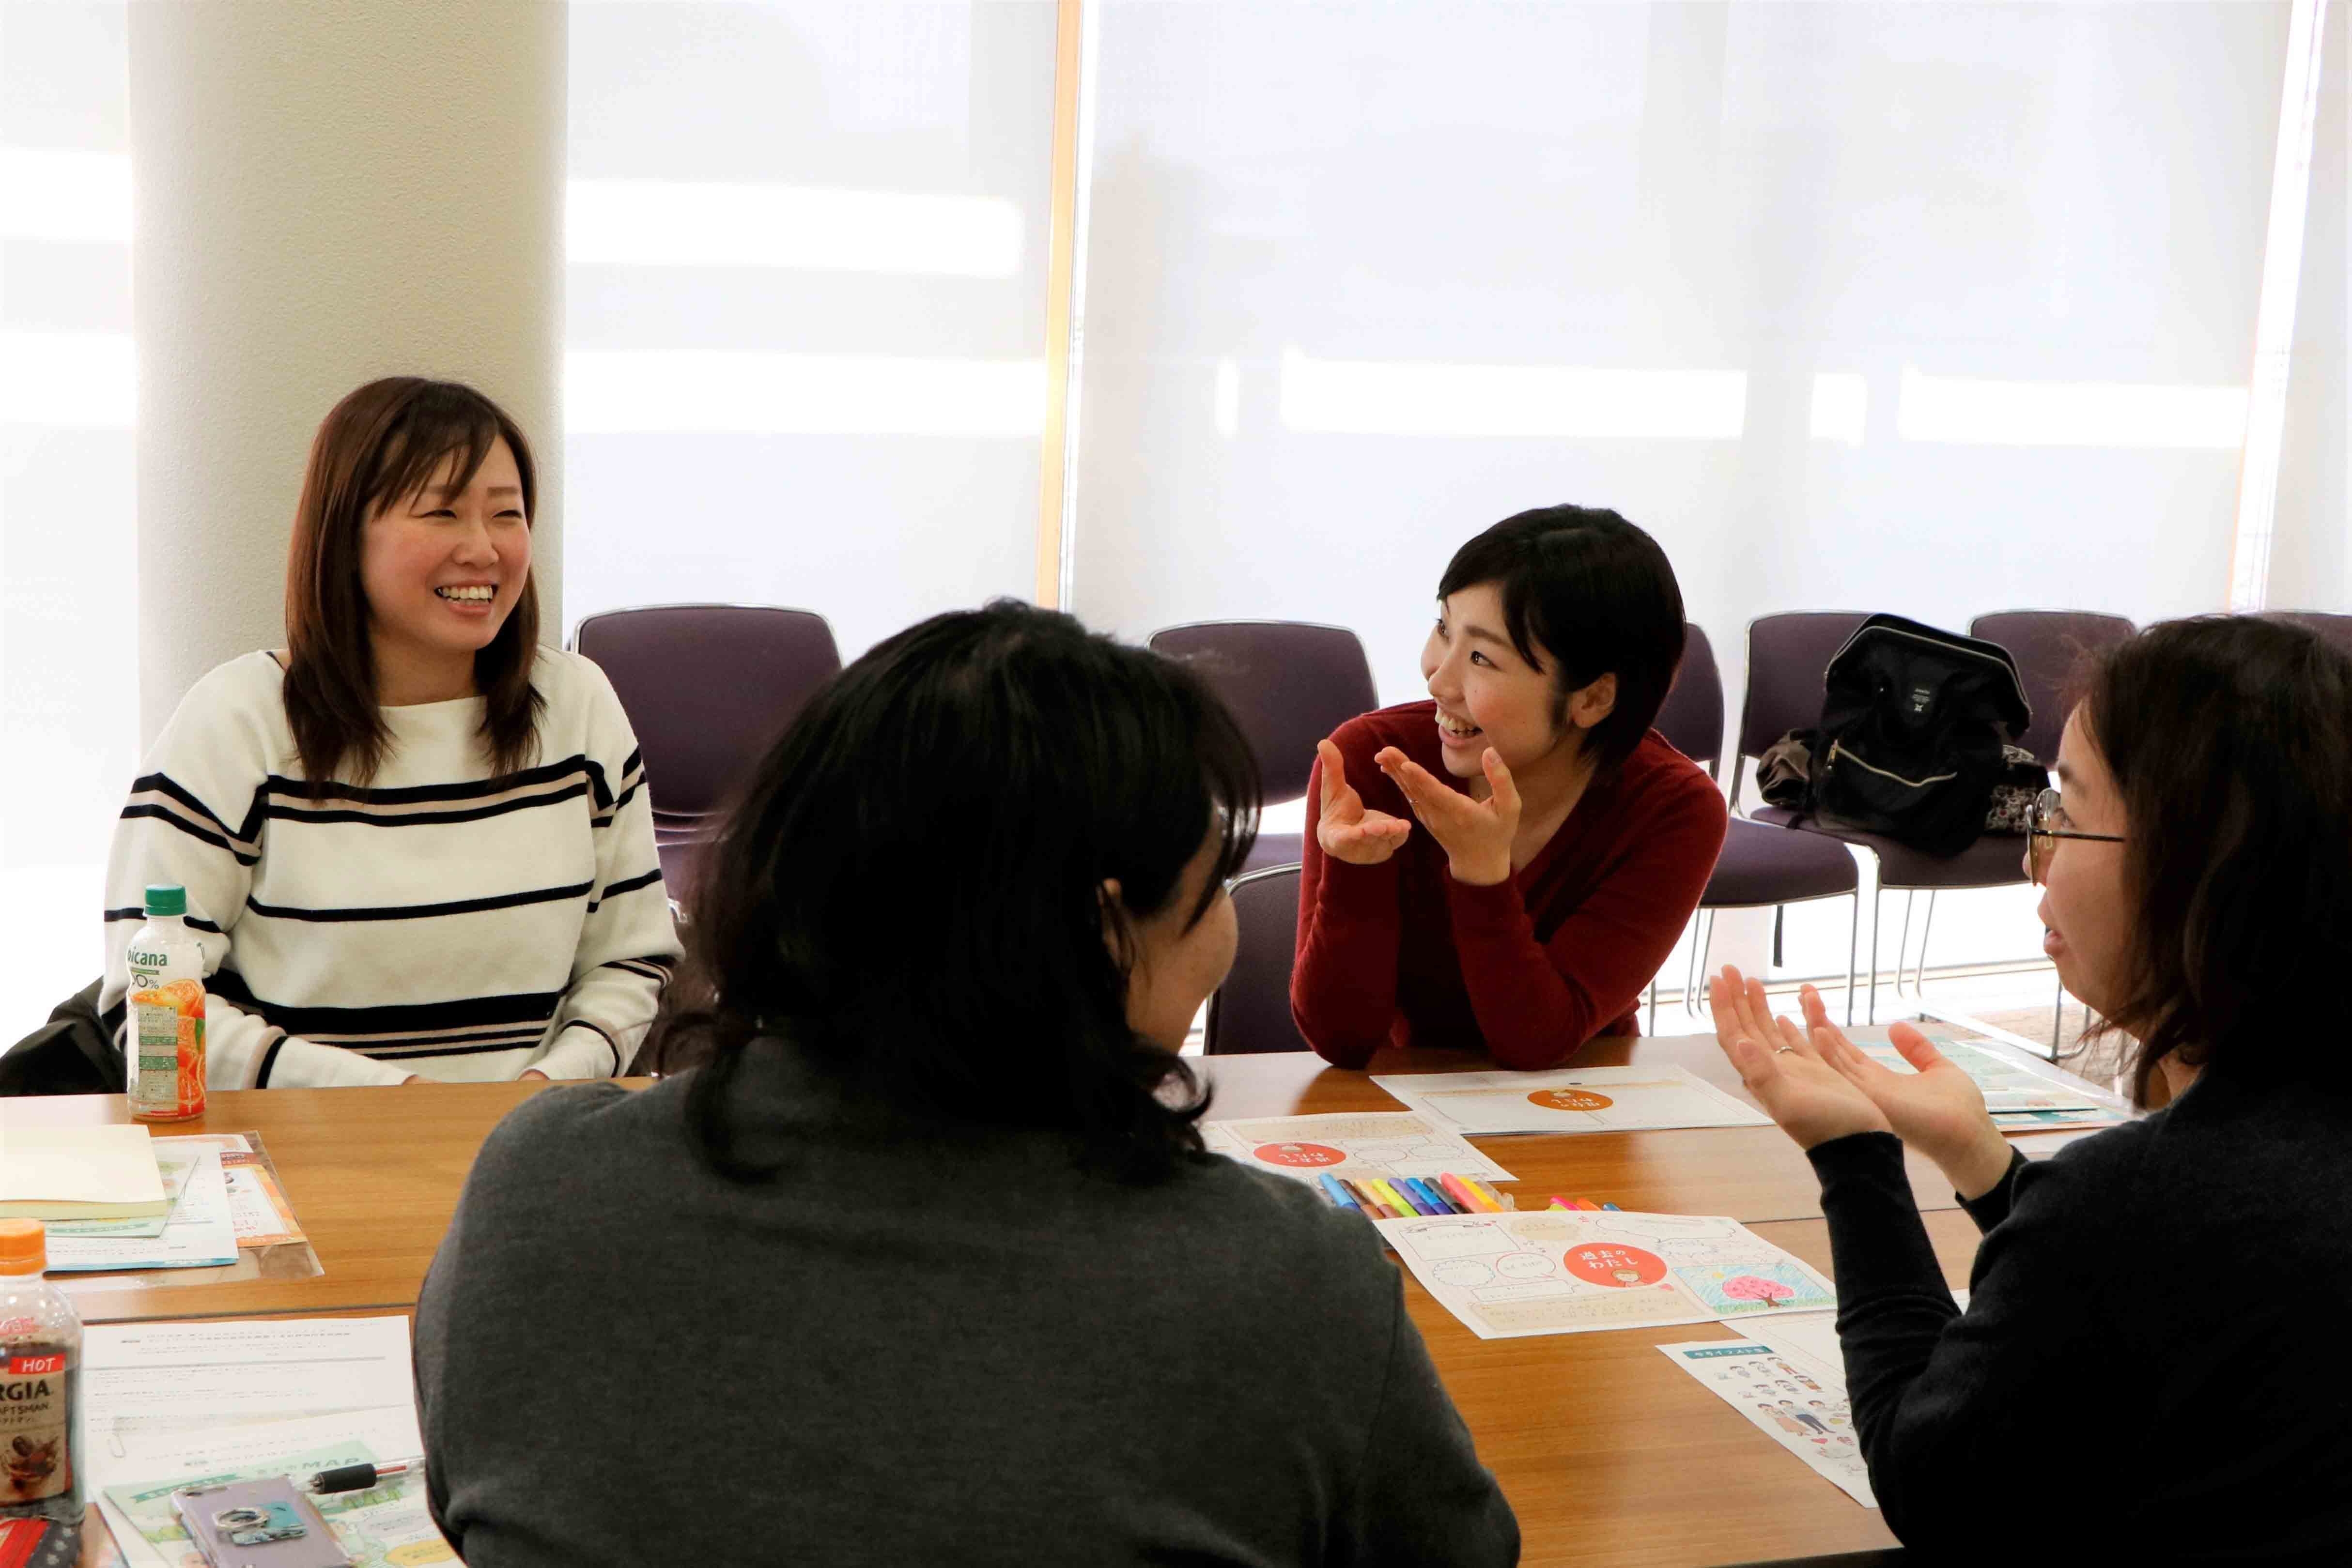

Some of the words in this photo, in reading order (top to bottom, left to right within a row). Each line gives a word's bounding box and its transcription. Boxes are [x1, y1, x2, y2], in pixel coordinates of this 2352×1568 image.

[131, 973, 159, 989] 0%
[1578, 1250, 1626, 1260] 過去の
[1588, 1257, 1639, 1269] わたし
[22, 1357, 56, 1372] HOT
